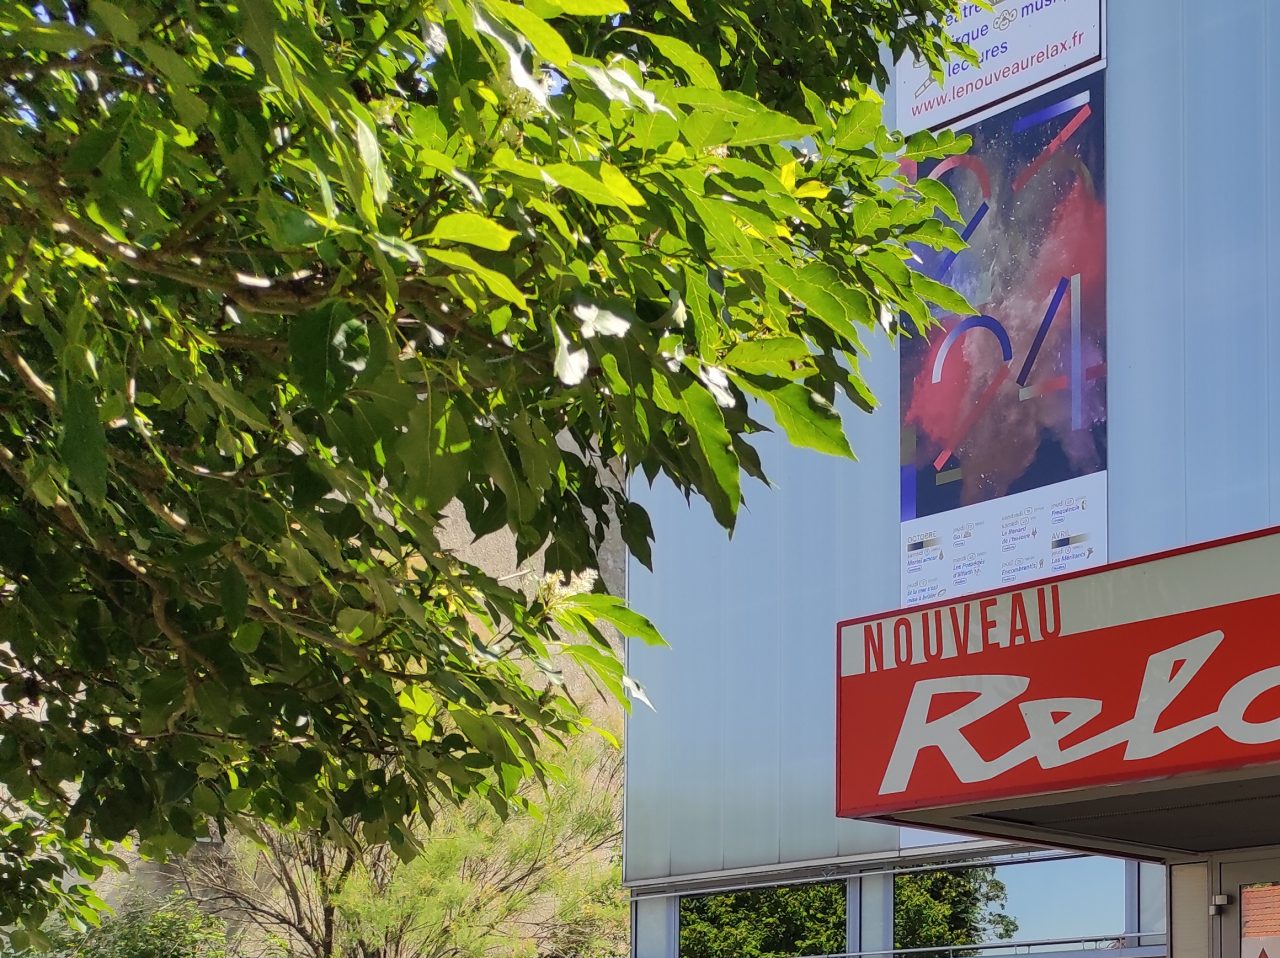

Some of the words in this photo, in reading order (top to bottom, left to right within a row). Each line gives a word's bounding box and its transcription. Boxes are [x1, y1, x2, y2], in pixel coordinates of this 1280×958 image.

[911, 30, 1085, 117] www.lenouveaurelax.fr
[948, 41, 1008, 77] lecures
[908, 530, 936, 543] OCTOBRE
[1052, 529, 1069, 540] AVRIL
[864, 584, 1061, 673] NOUVEAU
